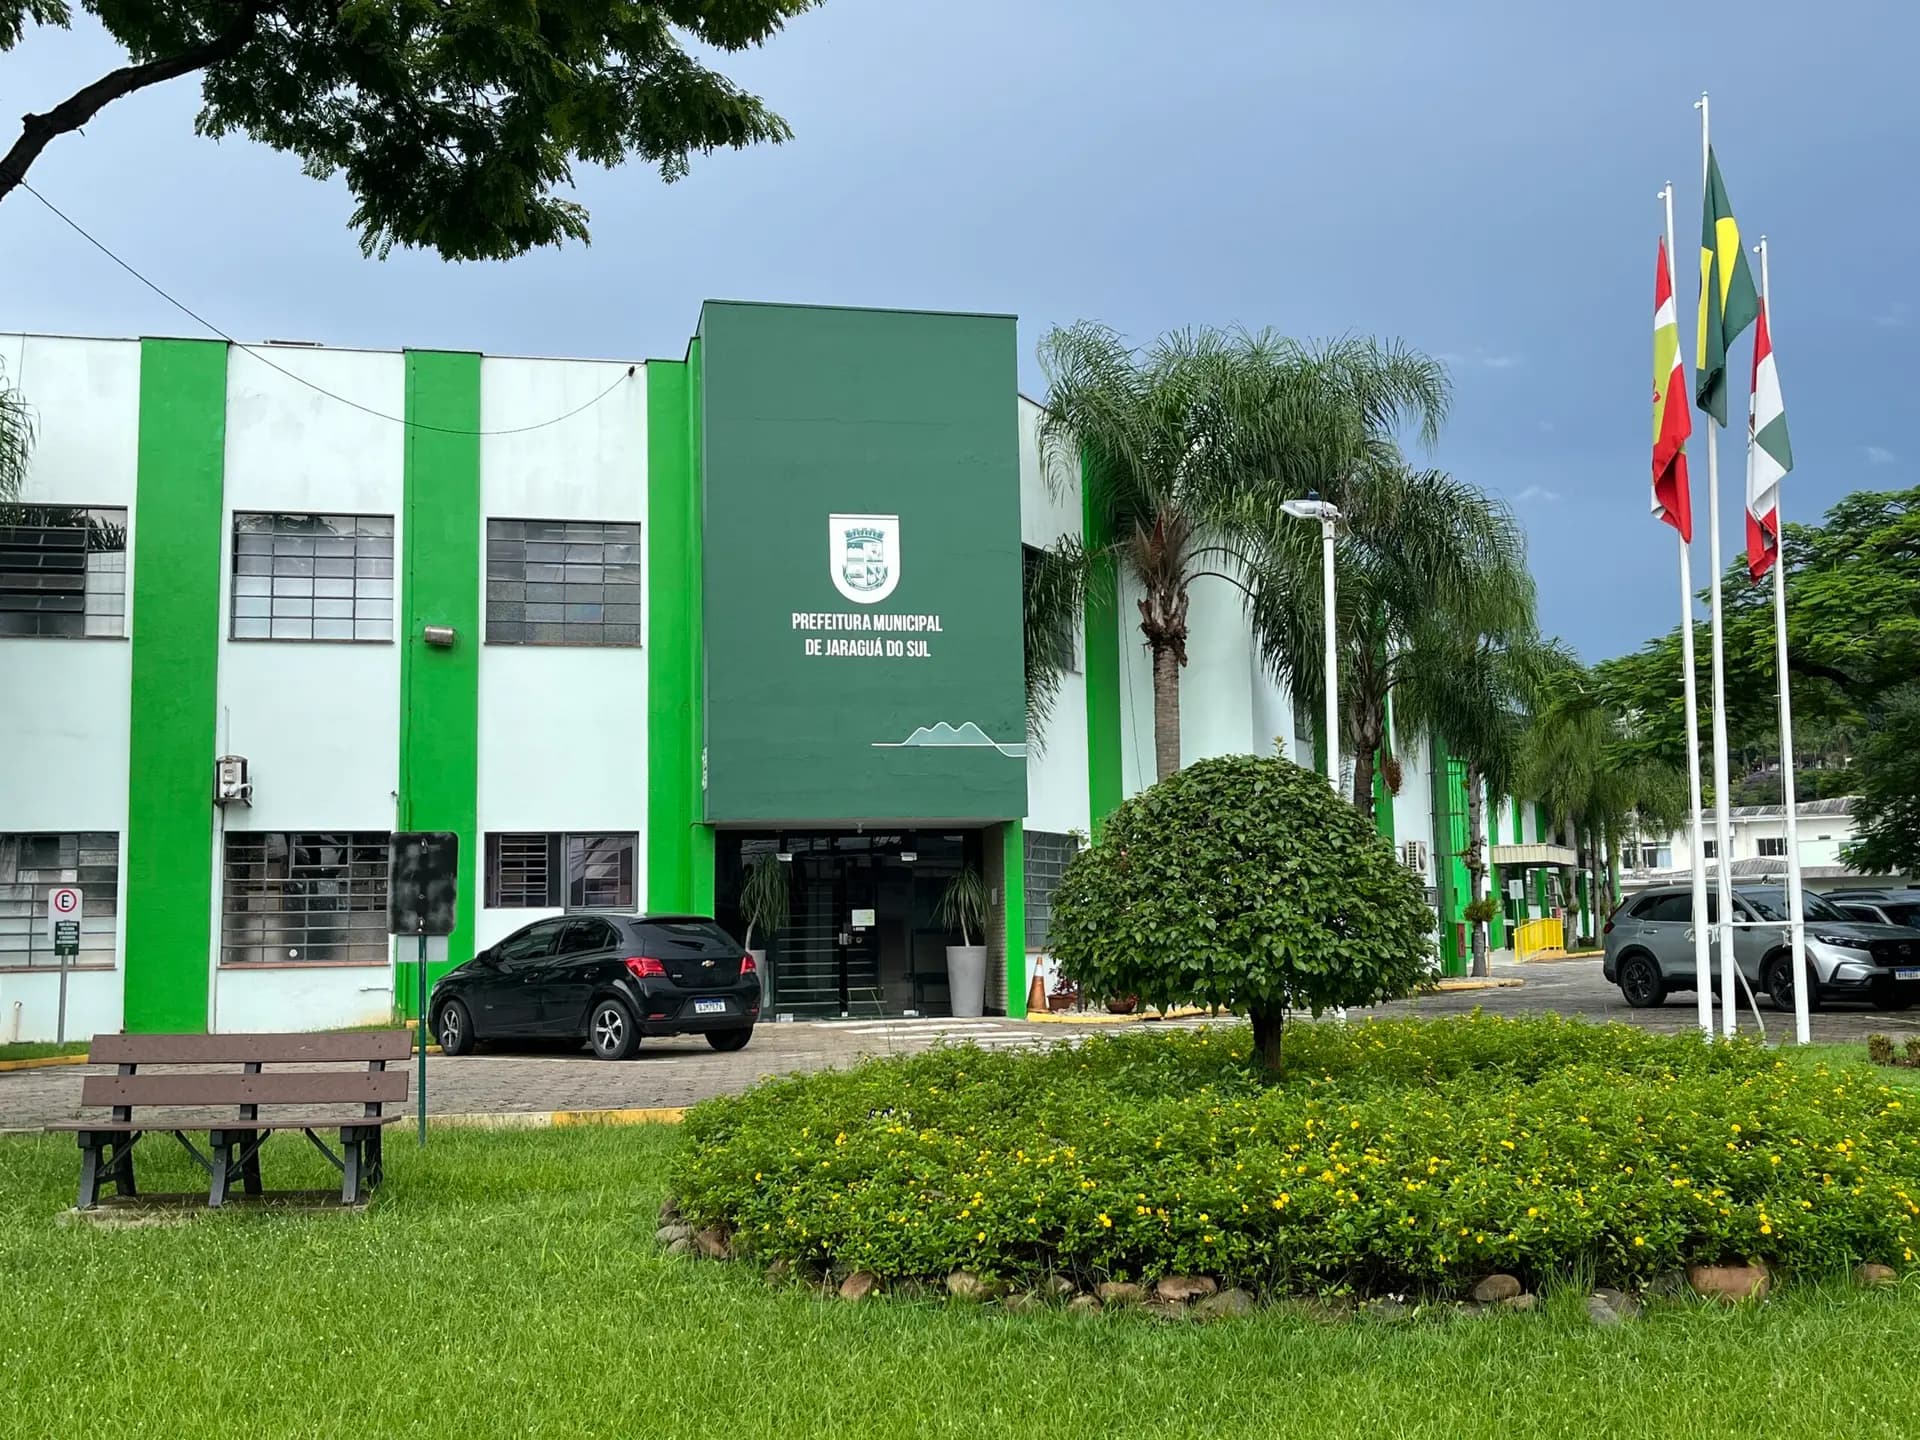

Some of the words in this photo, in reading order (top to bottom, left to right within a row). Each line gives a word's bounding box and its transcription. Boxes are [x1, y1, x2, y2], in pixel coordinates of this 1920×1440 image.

[792, 612, 872, 631] PREFEITURA
[873, 614, 943, 632] MUNICIPAL
[805, 638, 822, 656] DE
[825, 636, 883, 657] JARAGUÁ
[886, 639, 903, 657] DO
[906, 640, 931, 658] SUL
[62, 895, 70, 908] E
